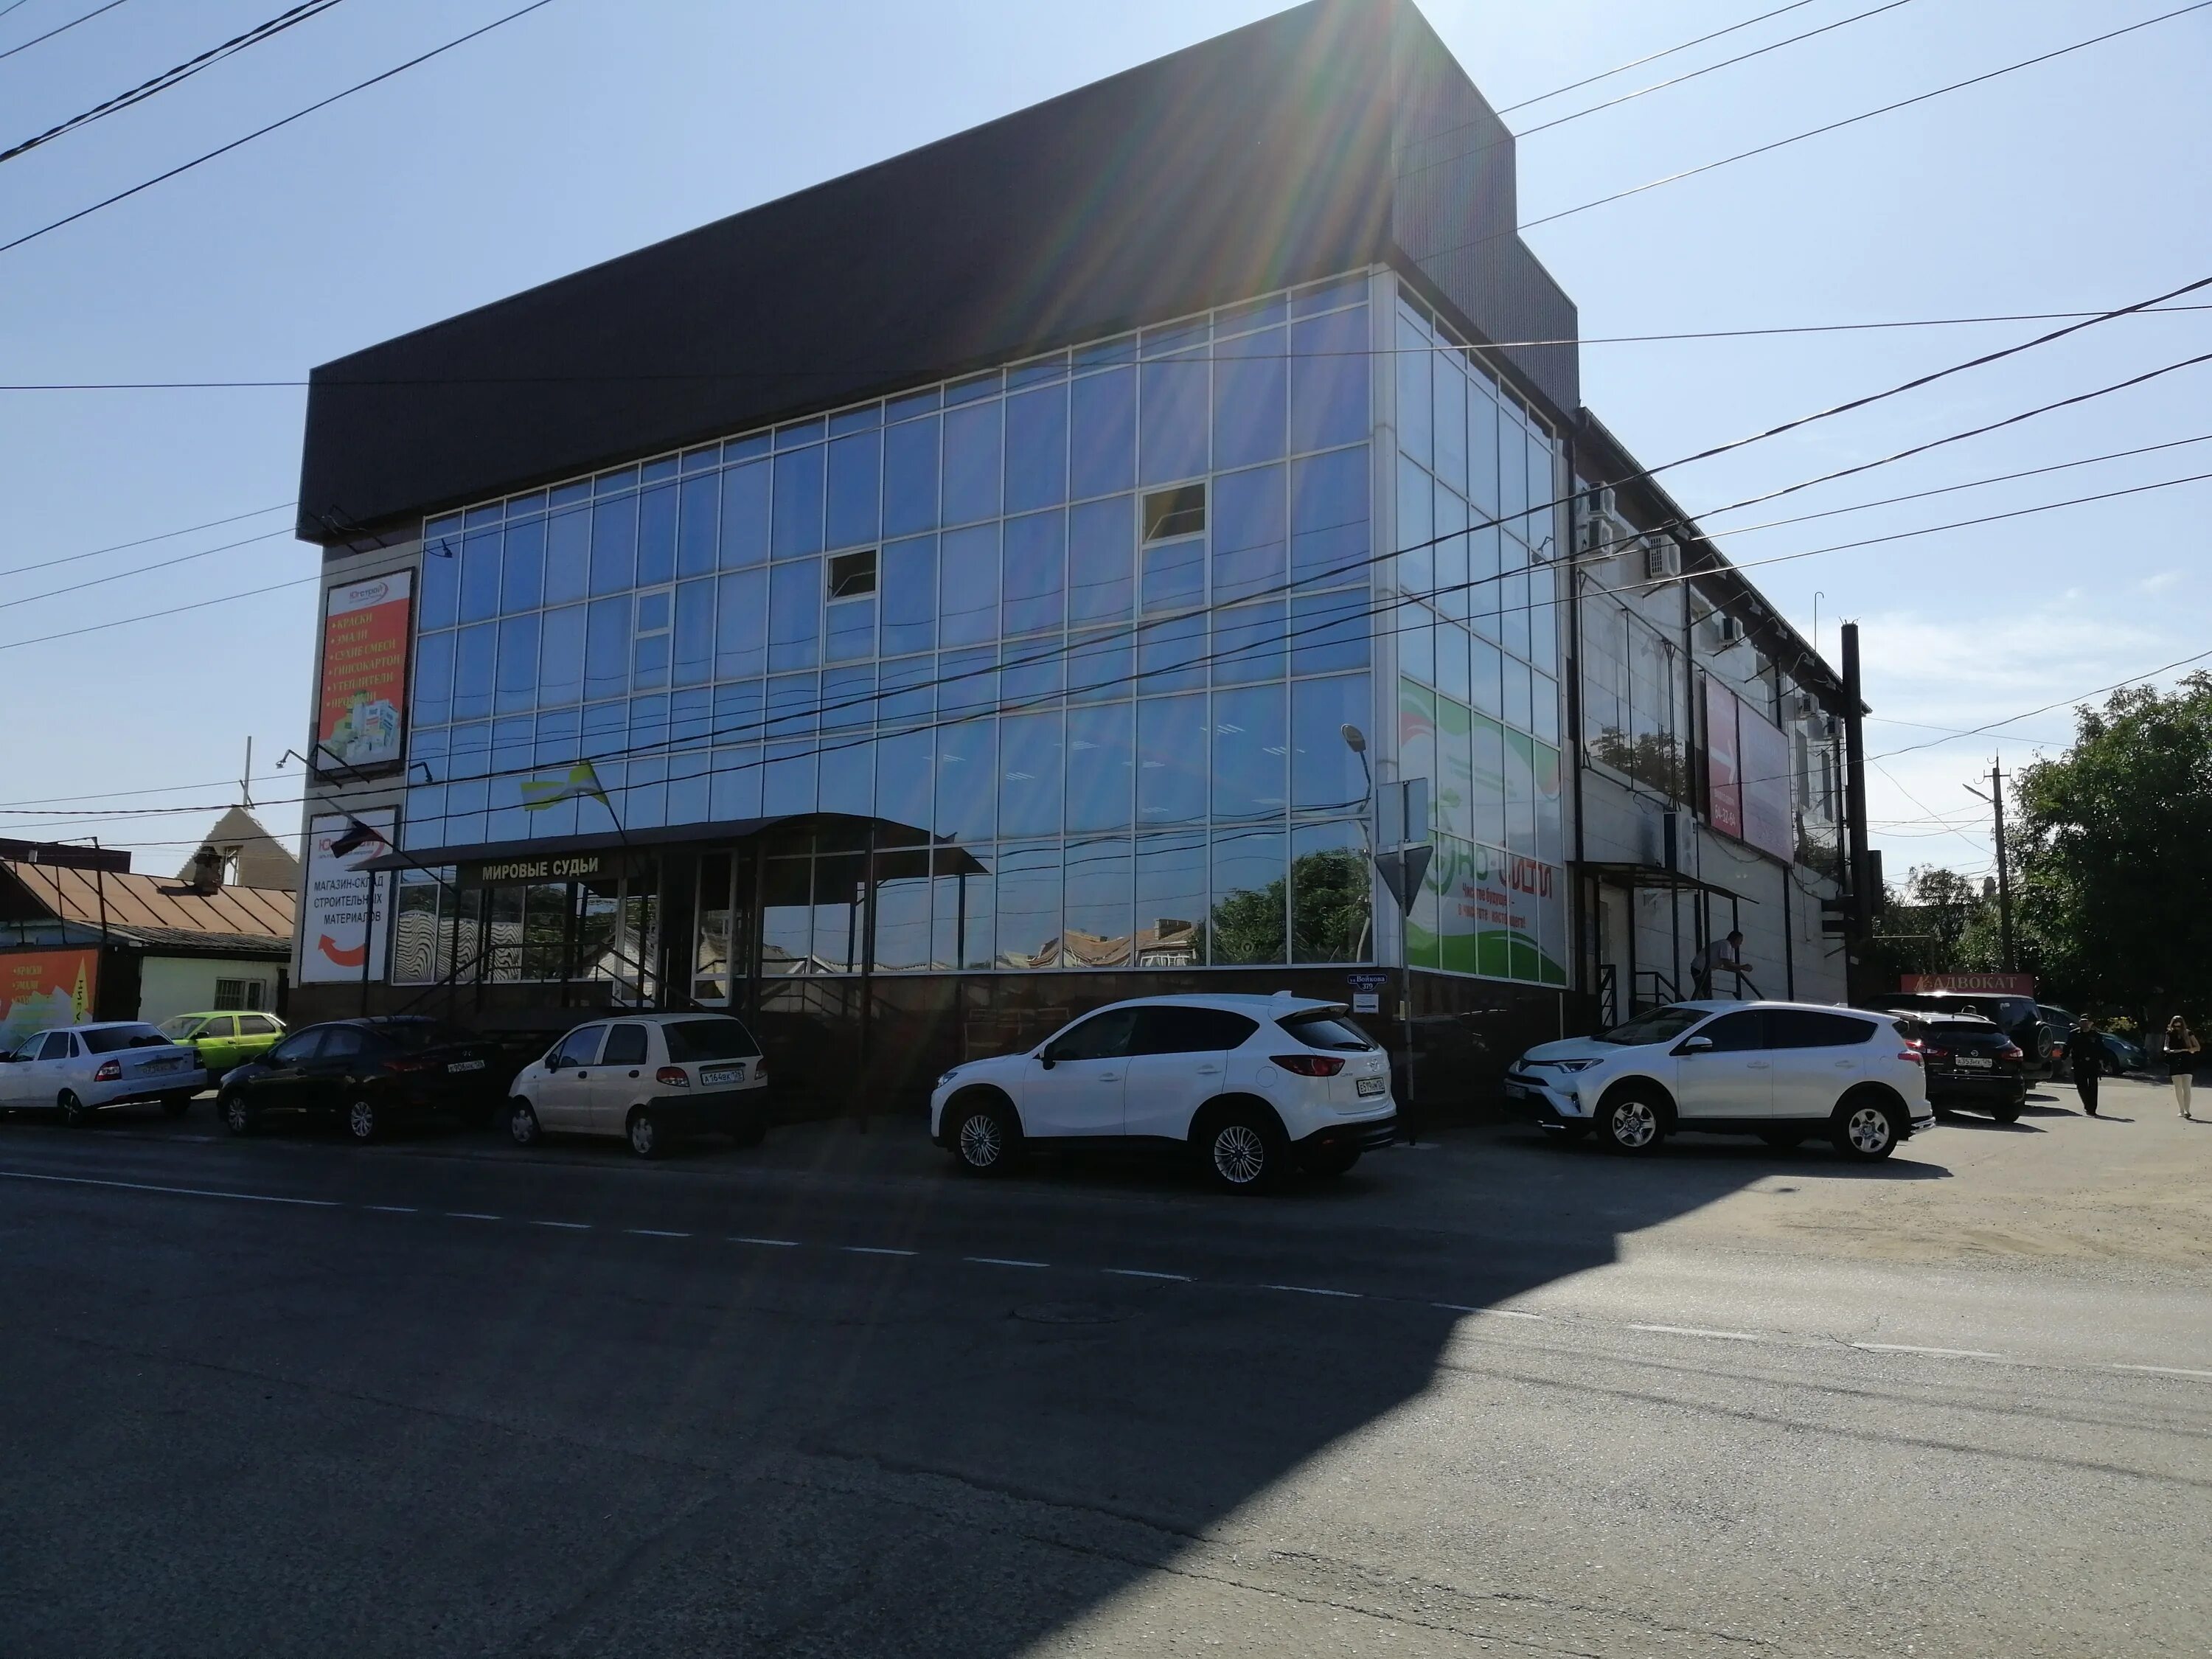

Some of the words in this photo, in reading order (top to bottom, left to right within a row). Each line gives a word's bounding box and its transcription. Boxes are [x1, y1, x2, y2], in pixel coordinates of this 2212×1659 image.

[338, 613, 372, 629] КРАСКИ
[336, 630, 368, 645] ЭМАЛИ
[335, 646, 363, 661] СУХИЕ
[365, 639, 395, 654] СМЕСИ
[333, 654, 400, 676] ГИПСОКАРТОН
[333, 672, 394, 691] УТЕПЛИТЕЛИ
[331, 692, 376, 709] ПРОФЛИ
[482, 861, 549, 880] МИРОВЫЕ
[553, 857, 599, 877] СУДЬИ
[1486, 887, 1511, 908] будуще
[1491, 910, 1527, 929] настощего!
[1933, 976, 2017, 990] АДВОКАТ
